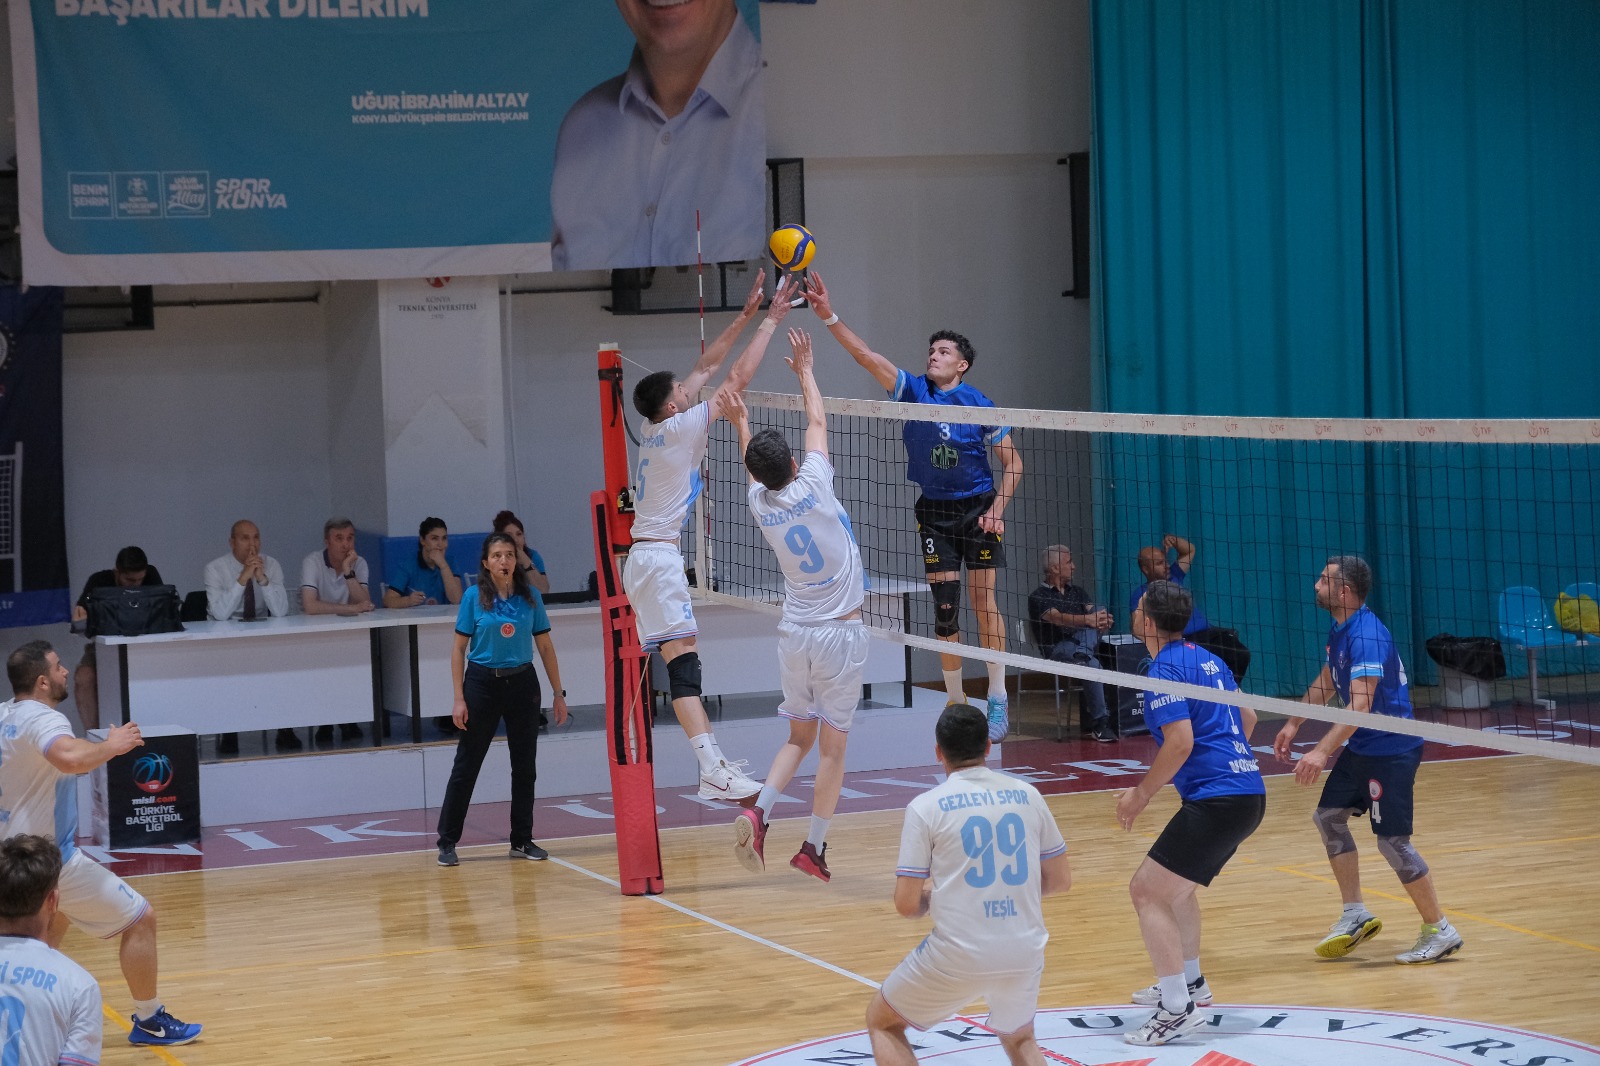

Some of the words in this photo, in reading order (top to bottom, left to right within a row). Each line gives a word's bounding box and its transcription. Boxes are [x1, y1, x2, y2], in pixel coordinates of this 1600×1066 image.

[55, 0, 271, 26] BAŞARILAR
[351, 90, 399, 110] UĞUR
[401, 90, 474, 110] İBRAHİM
[475, 93, 529, 109] ALTAY
[352, 114, 387, 124] KONYA
[387, 112, 446, 125] BÜYÜKŞEHİR
[447, 111, 487, 122] BELEDİYE
[487, 112, 529, 123] BAŞKANI
[215, 178, 271, 194] SPOR
[216, 189, 287, 209] KONYA
[940, 422, 951, 441] 3
[783, 524, 825, 574] 9
[925, 537, 935, 554] 3
[682, 602, 693, 620] 5
[131, 796, 177, 805] misli.com
[996, 789, 1030, 806] SPOR
[125, 813, 183, 825] BASKETBOL
[134, 805, 175, 816] TÜRKİYE
[1372, 801, 1382, 824] 4
[146, 823, 164, 832] LİGİ
[960, 812, 1029, 889] 99
[983, 895, 1017, 920] YEŞİL
[10, 965, 58, 993] SPOR
